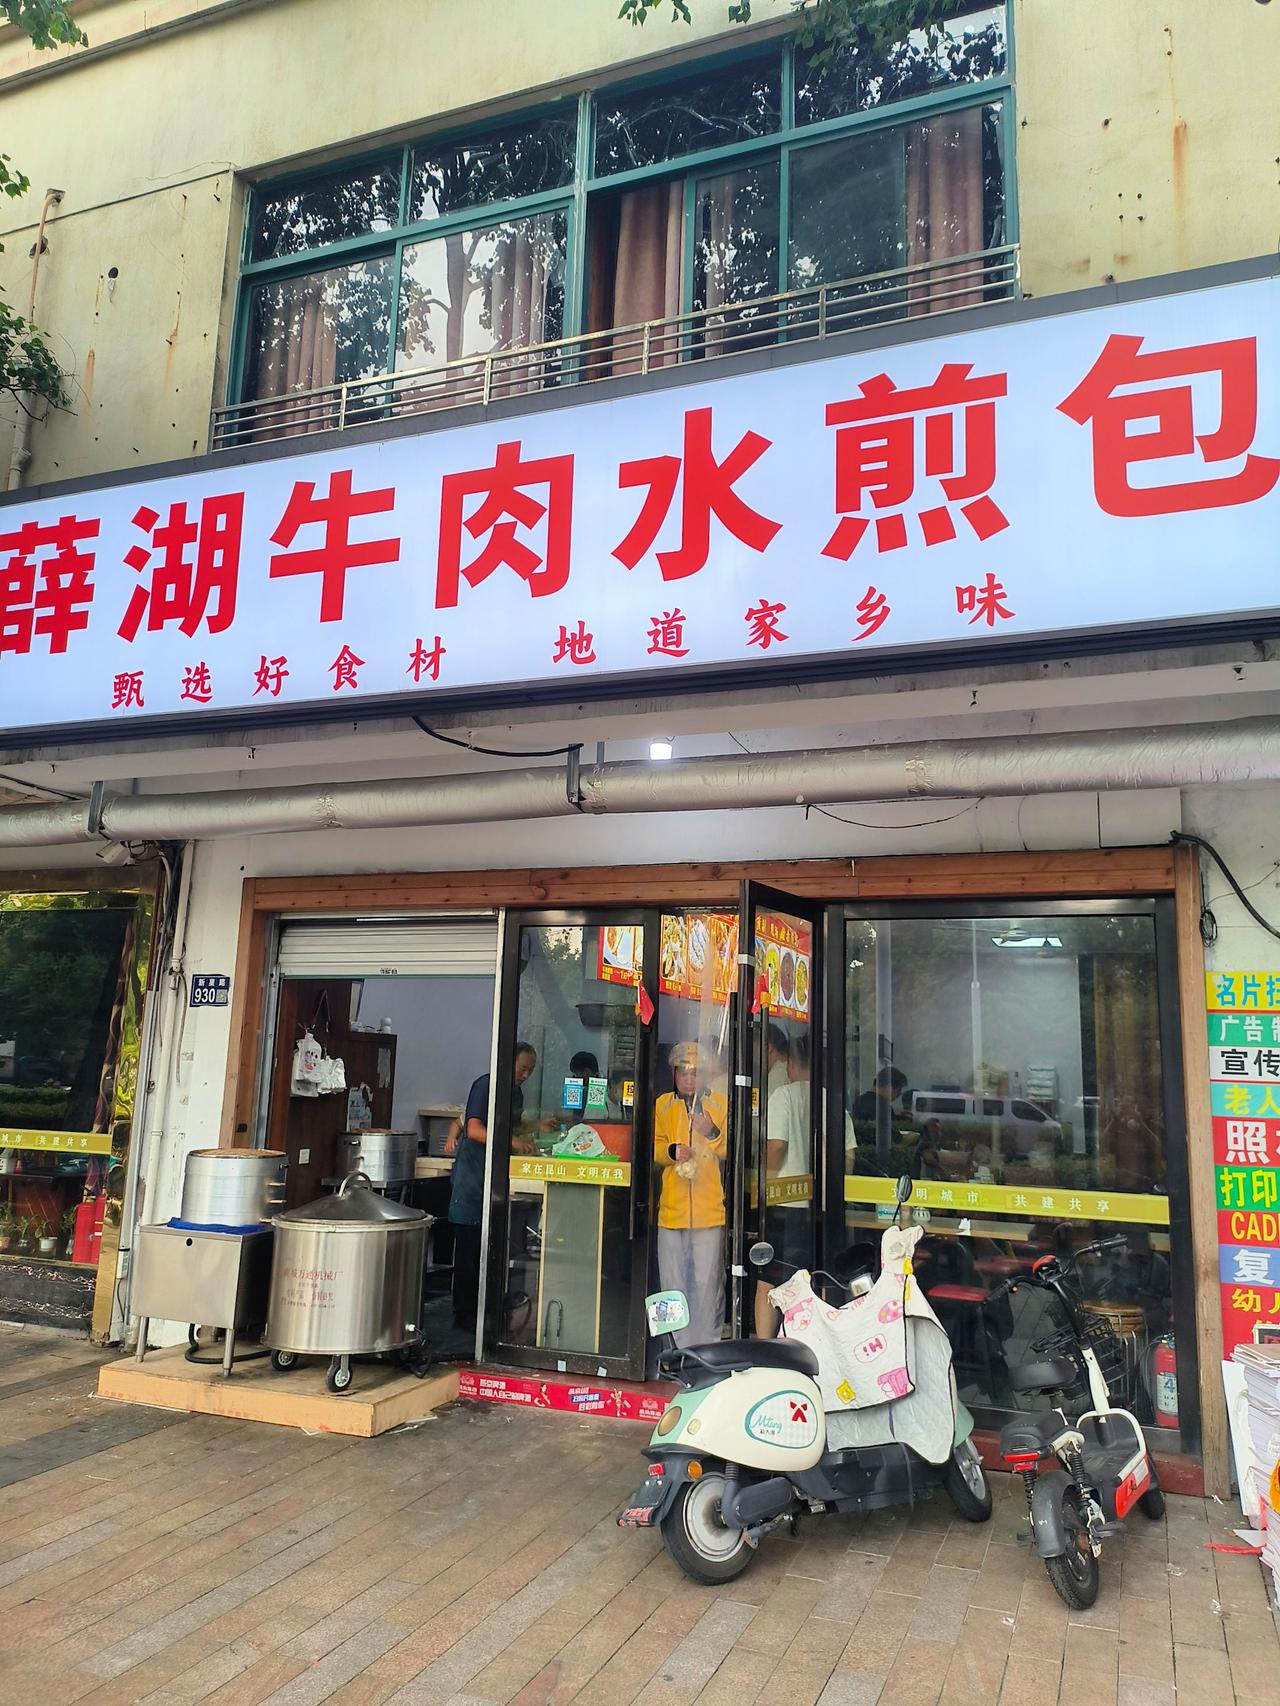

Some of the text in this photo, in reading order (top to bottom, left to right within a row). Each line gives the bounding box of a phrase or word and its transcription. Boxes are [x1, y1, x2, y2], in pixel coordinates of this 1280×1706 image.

[0, 335, 1280, 655] 薛湖牛肉水煎包
[111, 573, 1015, 709] 甄选好食材 地道家乡味
[194, 988, 216, 1003] 930
[1220, 1049, 1280, 1077] 宣传
[1223, 1084, 1280, 1115] 老人
[1225, 1120, 1280, 1165] 照
[521, 1162, 624, 1180] 家在昆山 文明有我
[1219, 1167, 1277, 1208] 打印
[1015, 1194, 1111, 1213] 共建共享
[1231, 1211, 1280, 1242] CAD
[1232, 1249, 1276, 1286] 复
